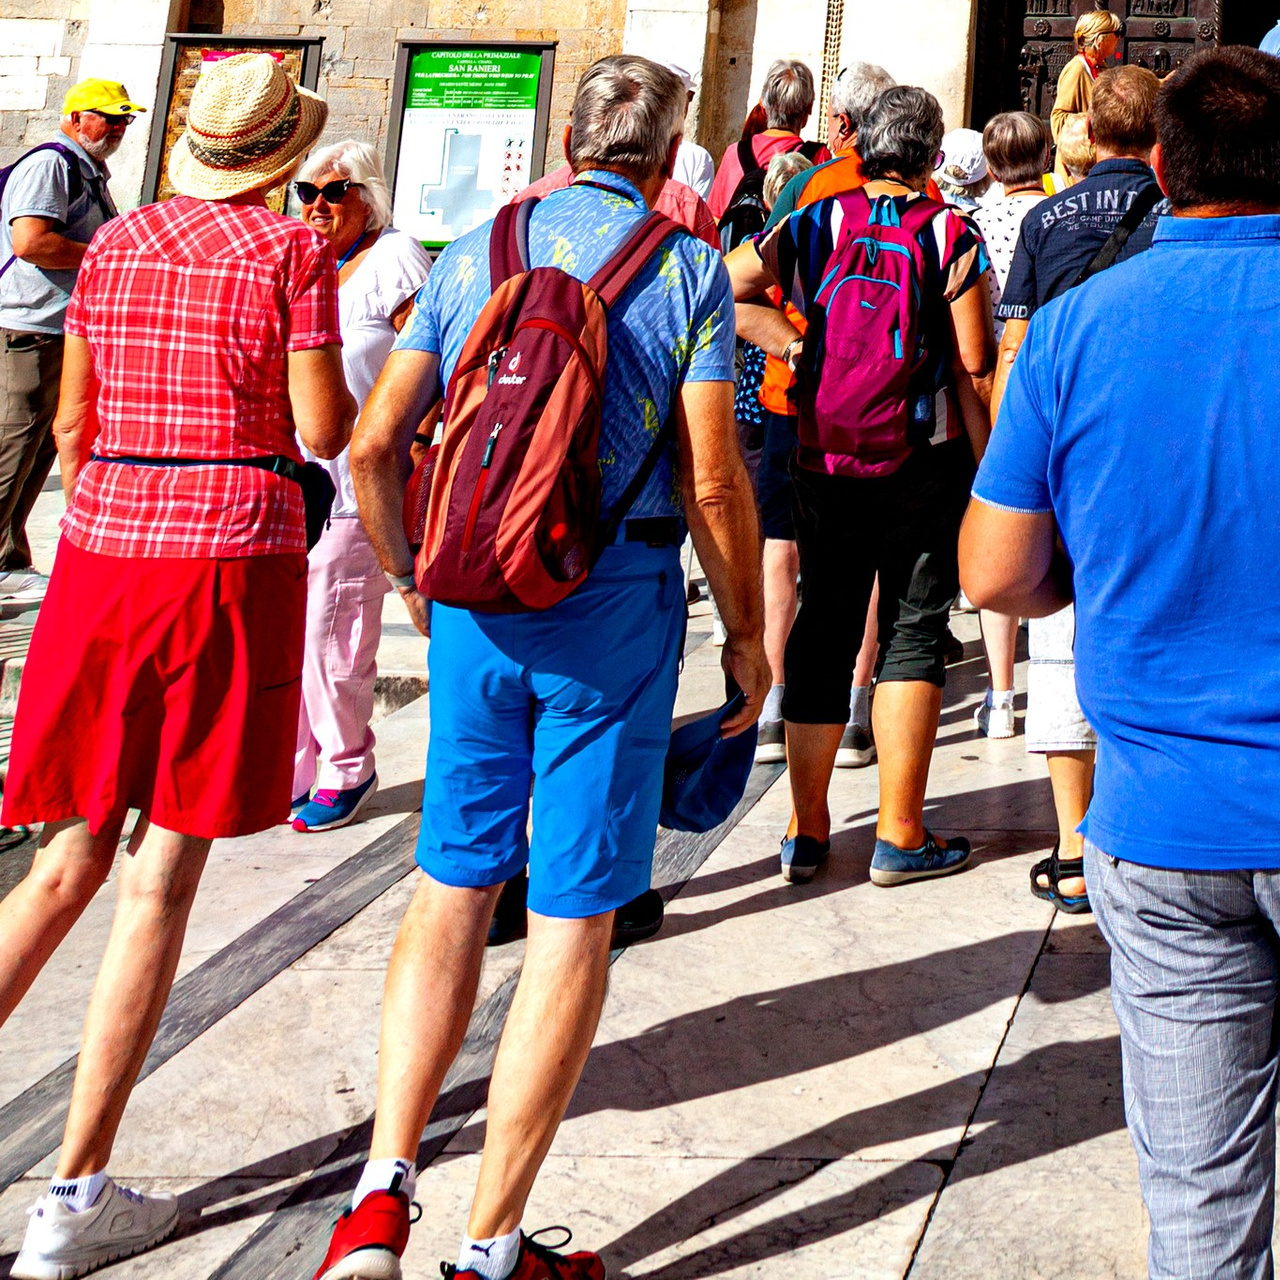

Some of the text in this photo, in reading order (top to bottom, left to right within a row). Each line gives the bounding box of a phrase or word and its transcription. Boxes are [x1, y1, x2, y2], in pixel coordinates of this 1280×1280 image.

[448, 64, 466, 72] SAN
[1041, 191, 1090, 229] BEST
[1096, 189, 1119, 209] IN
